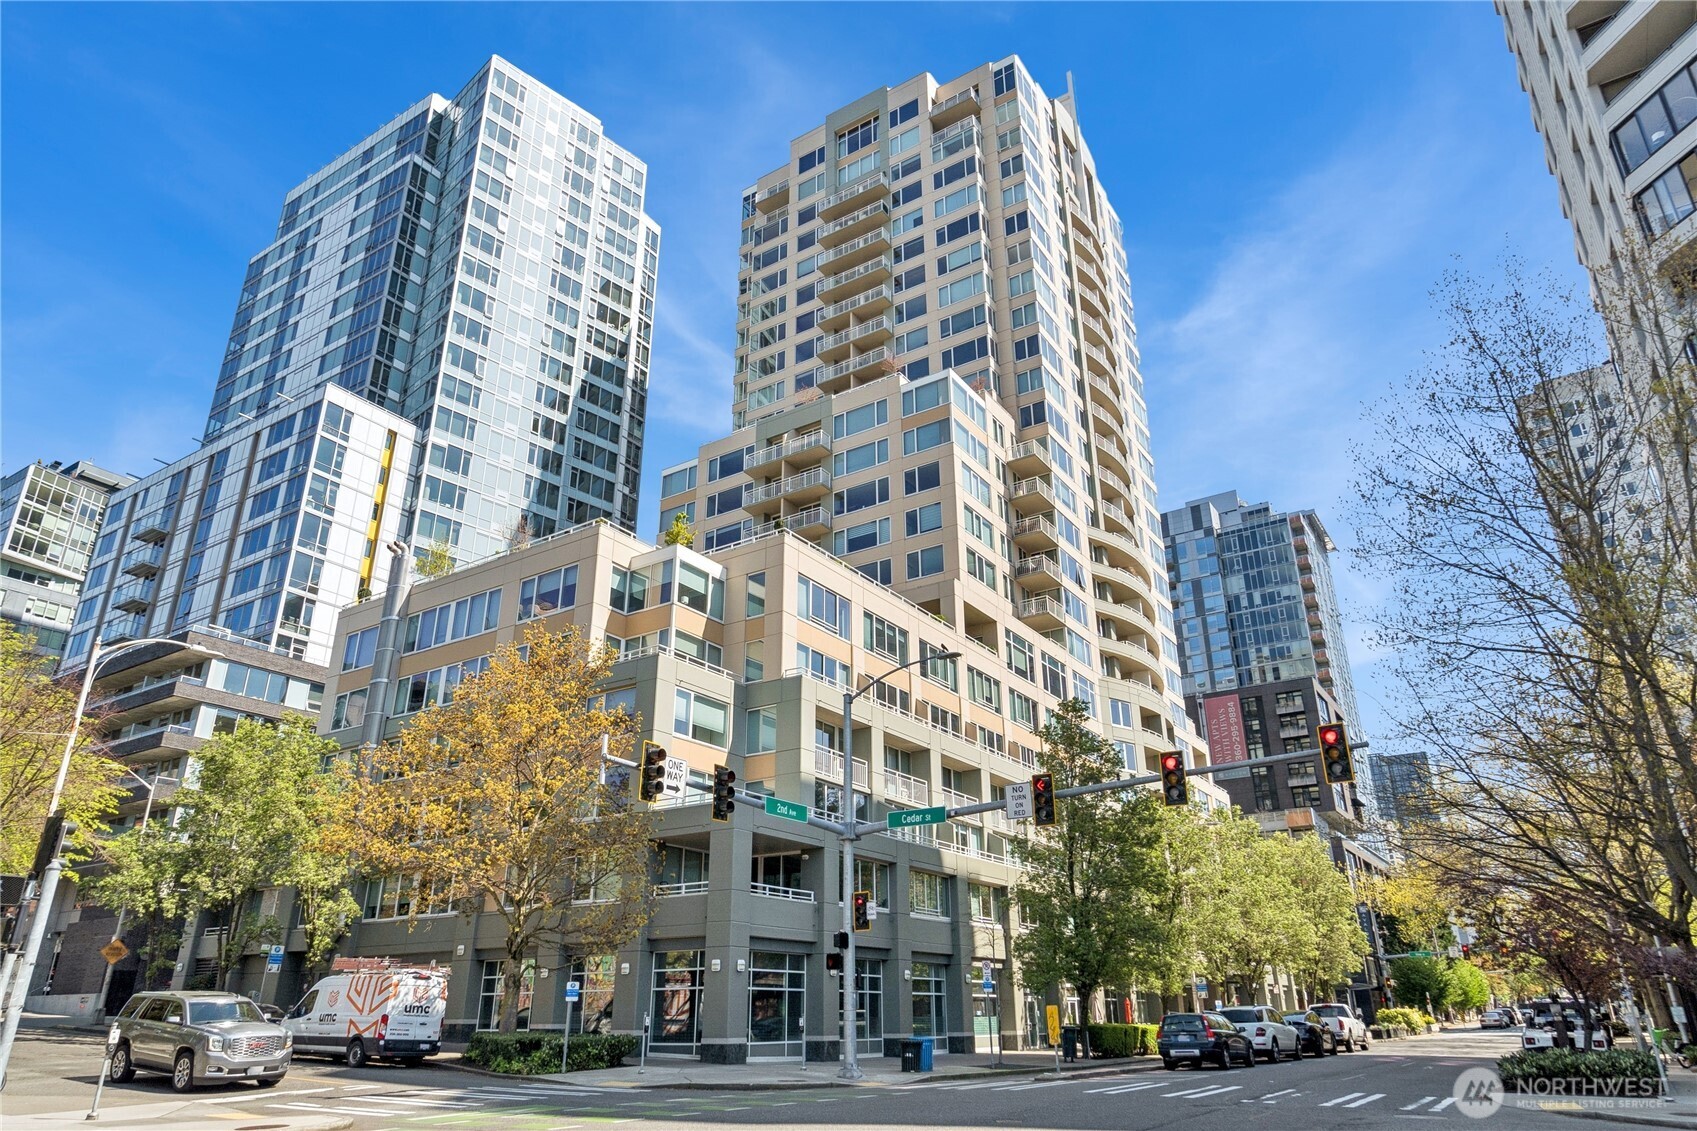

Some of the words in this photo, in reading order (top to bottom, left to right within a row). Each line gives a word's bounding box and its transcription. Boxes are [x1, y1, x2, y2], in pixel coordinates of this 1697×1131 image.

[1211, 719, 1220, 740] APTS
[1218, 708, 1228, 737] VIEWS
[1227, 701, 1243, 761] 360-295-9884
[1215, 744, 1224, 764] NEW
[1222, 738, 1232, 763] WITH
[668, 759, 684, 773] ONE
[666, 770, 684, 783] WAY
[1012, 785, 1024, 793] NO
[776, 803, 788, 815] 2nd
[789, 808, 797, 817] Ave
[901, 813, 923, 824] Cedar
[404, 1004, 430, 1014] umc
[319, 1013, 337, 1022] umc
